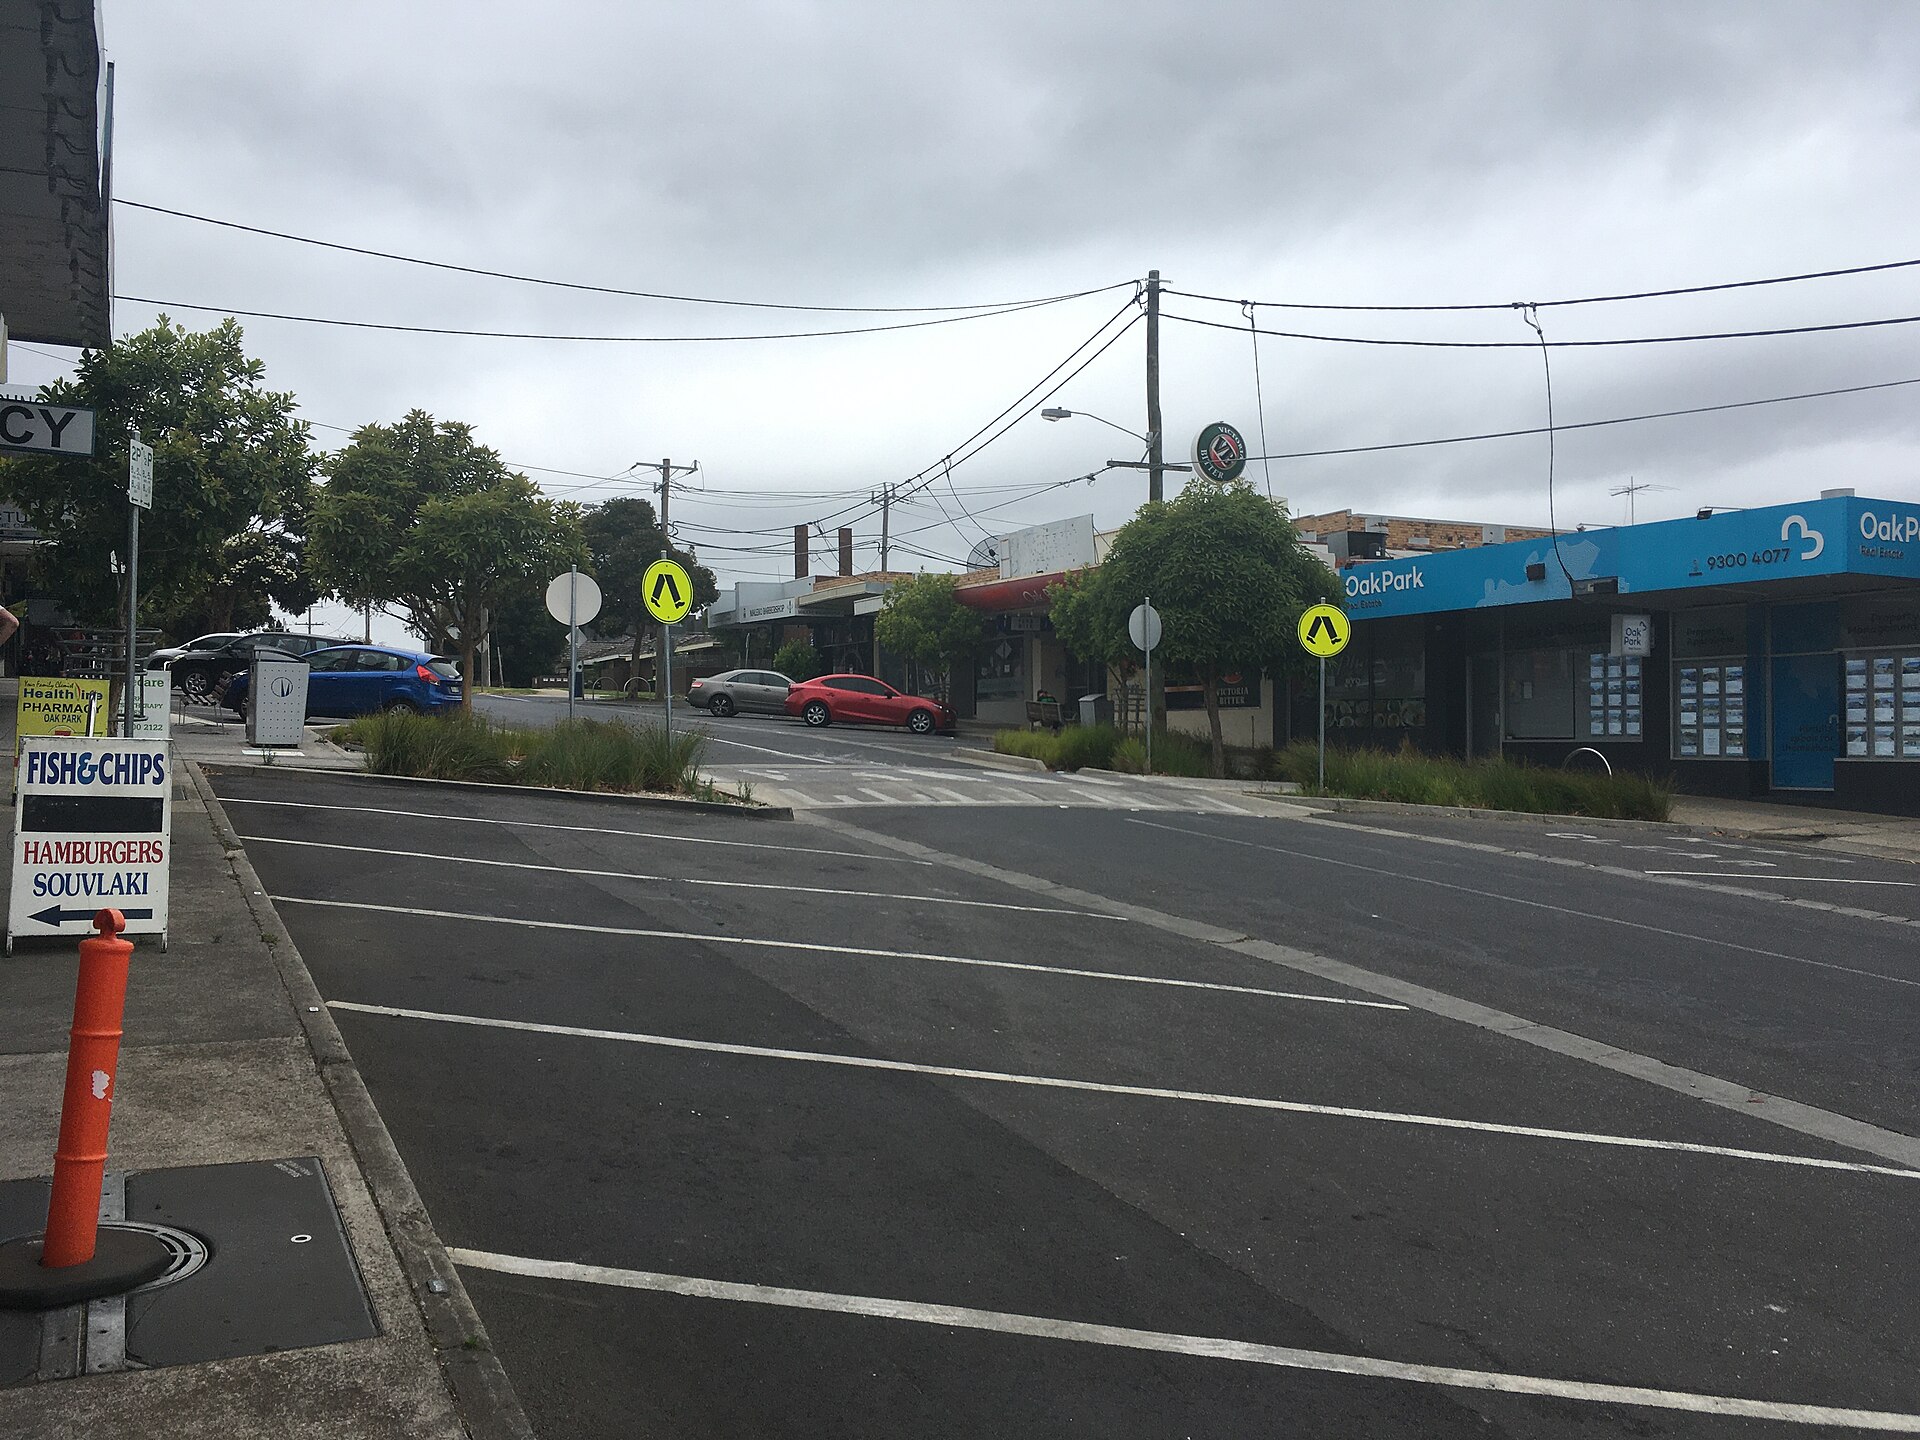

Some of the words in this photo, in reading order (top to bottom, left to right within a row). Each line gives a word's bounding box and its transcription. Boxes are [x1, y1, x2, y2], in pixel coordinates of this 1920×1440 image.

[1200, 448, 1224, 479] BITTER
[1860, 511, 1920, 543] OakP
[1707, 552, 1747, 570] 9300
[1752, 547, 1791, 564] 4077
[1625, 627, 1642, 637] Oak
[1624, 637, 1642, 646] Park
[1216, 686, 1249, 697] VICTORIA
[1219, 696, 1245, 705] BITTER
[22, 702, 103, 714] PHARMACY
[43, 713, 60, 723] OAK
[61, 714, 82, 724] PARK
[143, 723, 163, 731] 2122
[23, 840, 164, 865] HAMBURGERS
[32, 872, 149, 897] SOUVLAKI
